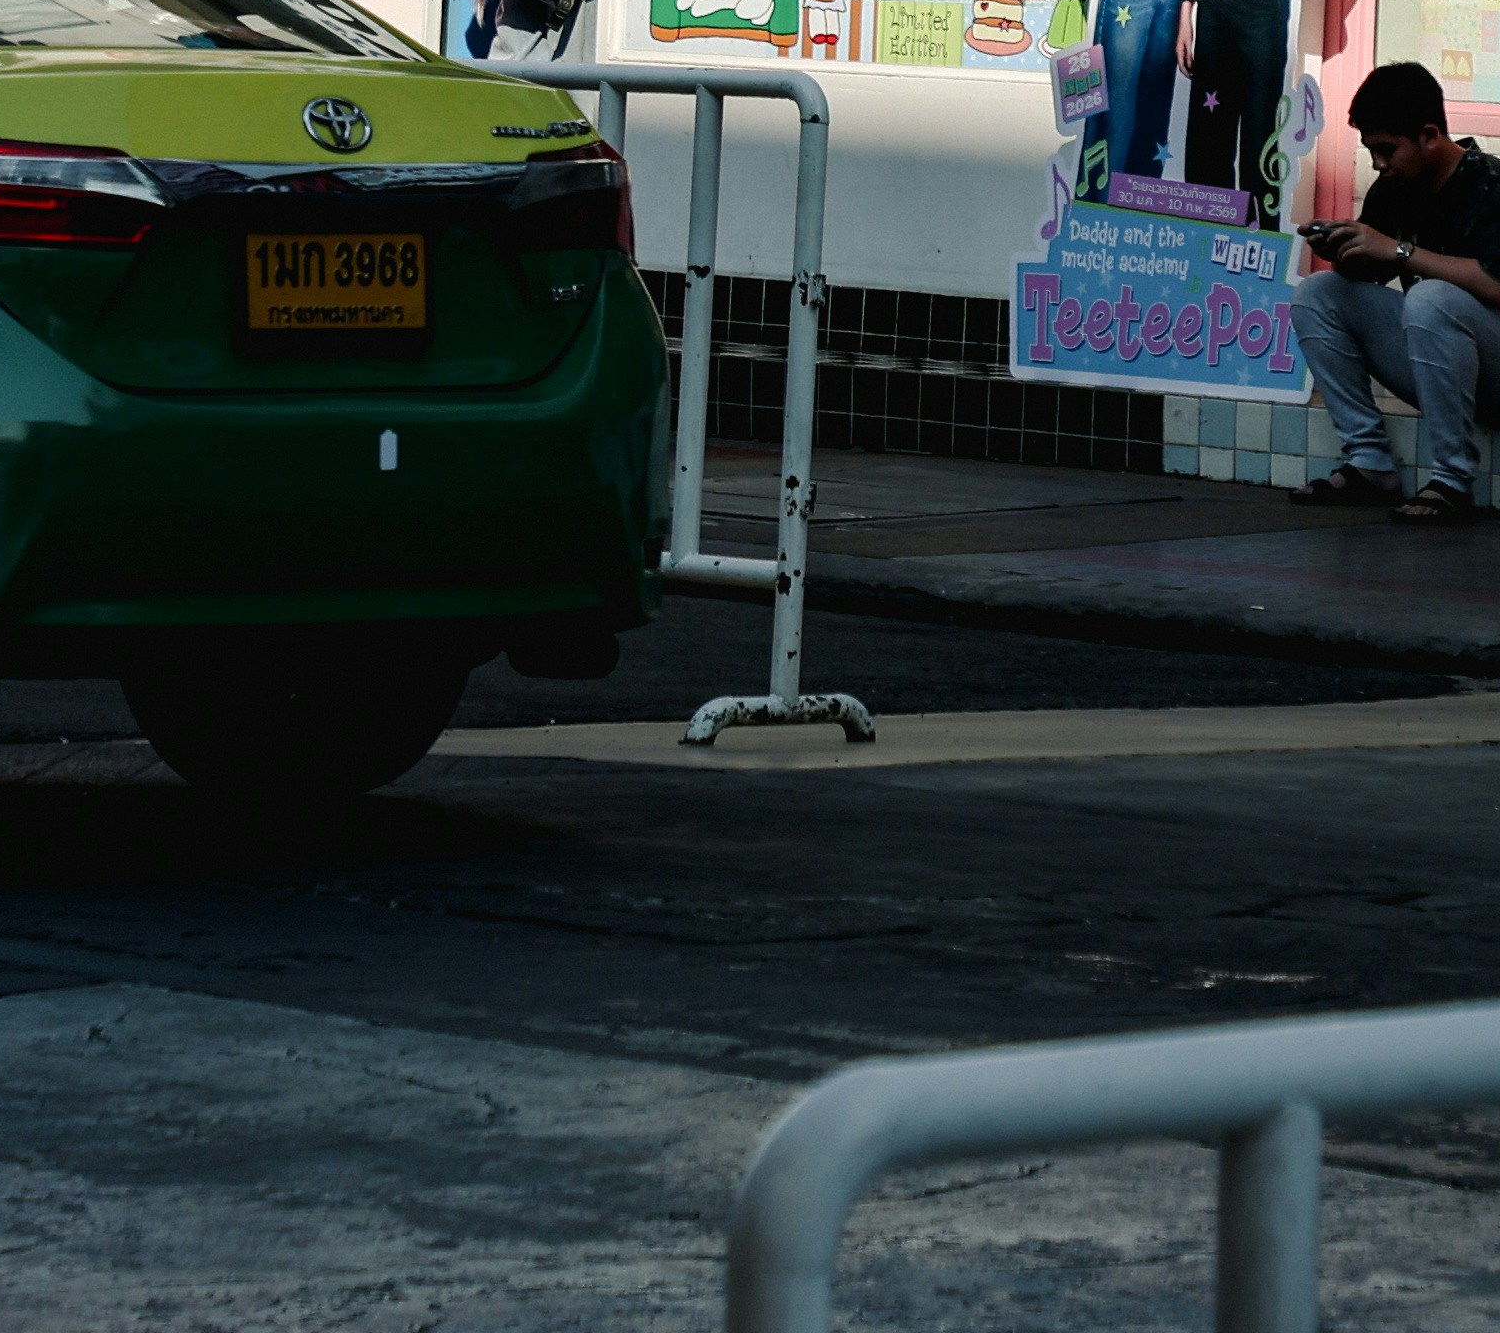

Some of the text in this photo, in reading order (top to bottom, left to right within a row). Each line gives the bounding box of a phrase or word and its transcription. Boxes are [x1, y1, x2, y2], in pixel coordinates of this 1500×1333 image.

[888, 6, 952, 33] Limited
[888, 34, 949, 60] Edition
[1069, 52, 1091, 75] 26
[1066, 91, 1103, 118] 2026
[1118, 191, 1133, 203] 30
[1168, 199, 1182, 211] 10
[1209, 205, 1238, 220] 2569
[1069, 218, 1185, 249] Daddy and the
[256, 241, 420, 288] 1มก 3968
[1061, 248, 1190, 281] muscle academy
